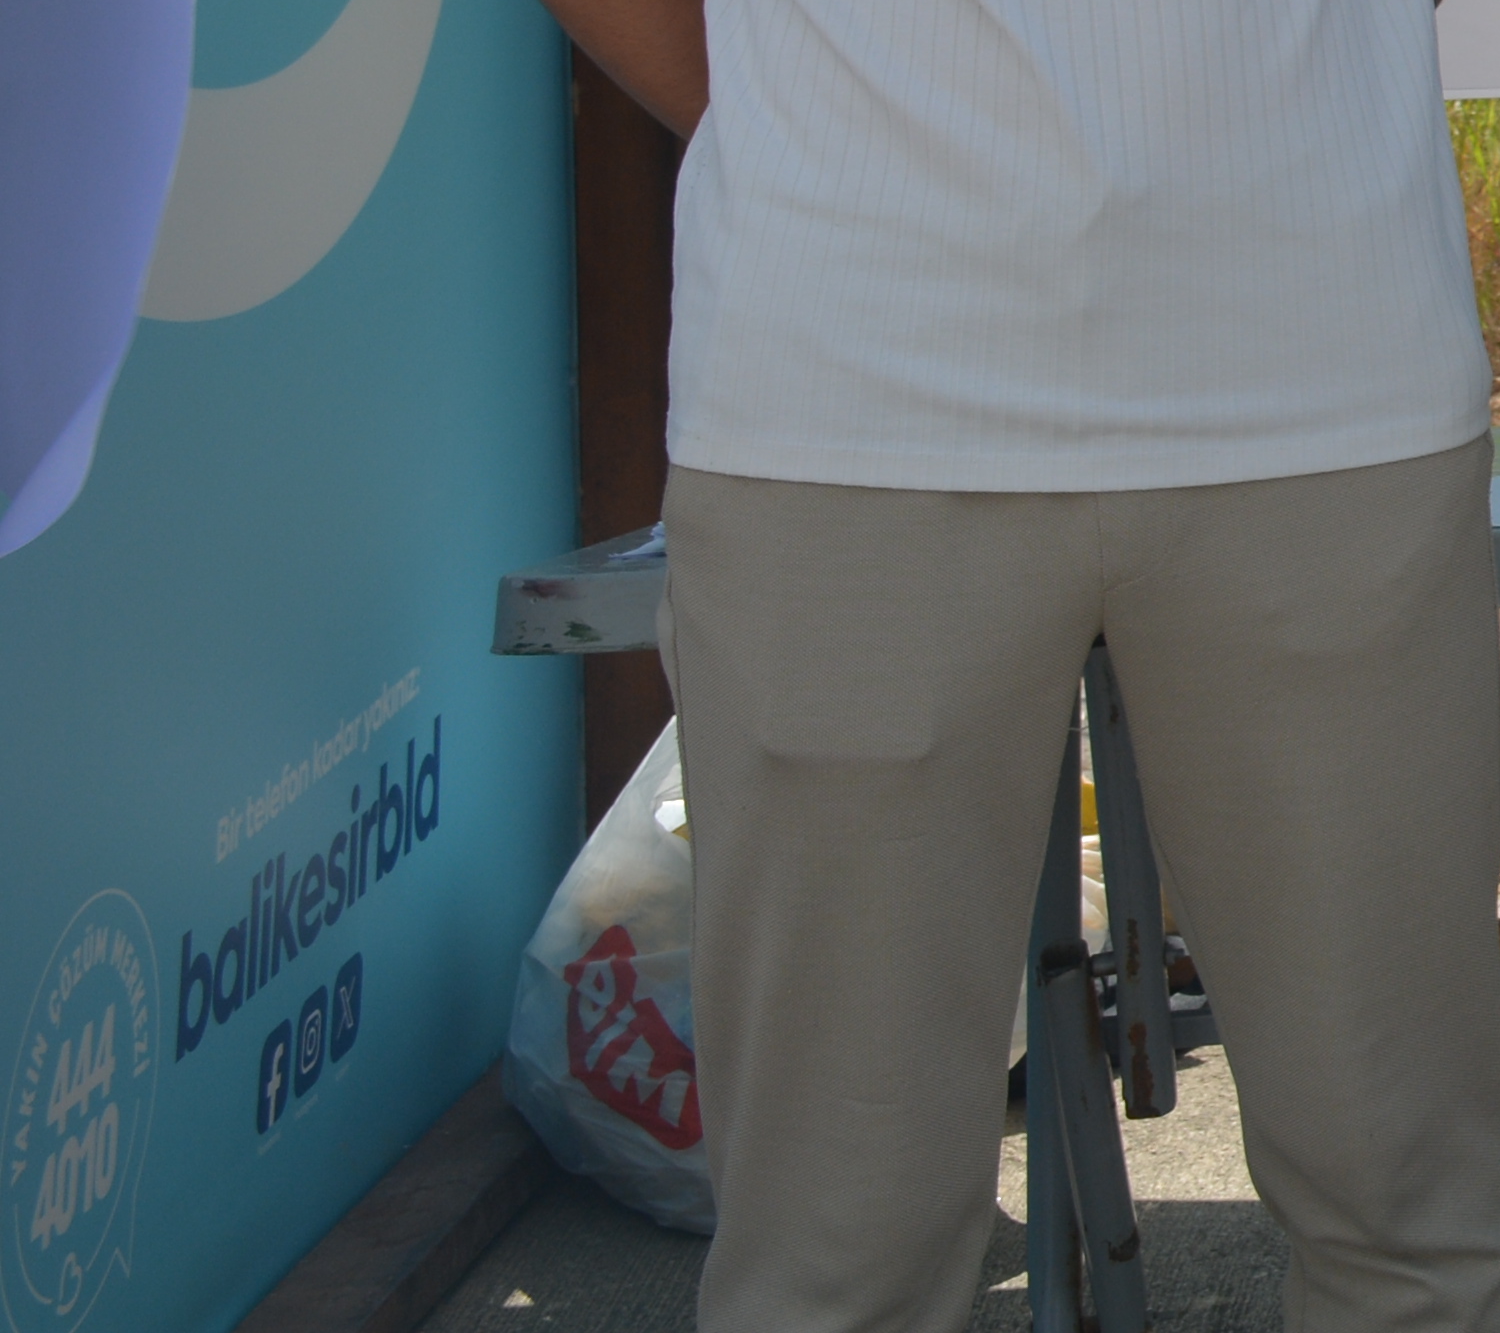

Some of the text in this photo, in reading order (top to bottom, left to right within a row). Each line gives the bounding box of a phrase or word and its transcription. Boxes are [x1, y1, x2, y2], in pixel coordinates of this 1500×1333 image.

[174, 713, 442, 1064] balikesirbld
[46, 1000, 116, 1137] 444
[30, 1101, 119, 1252] 4010
